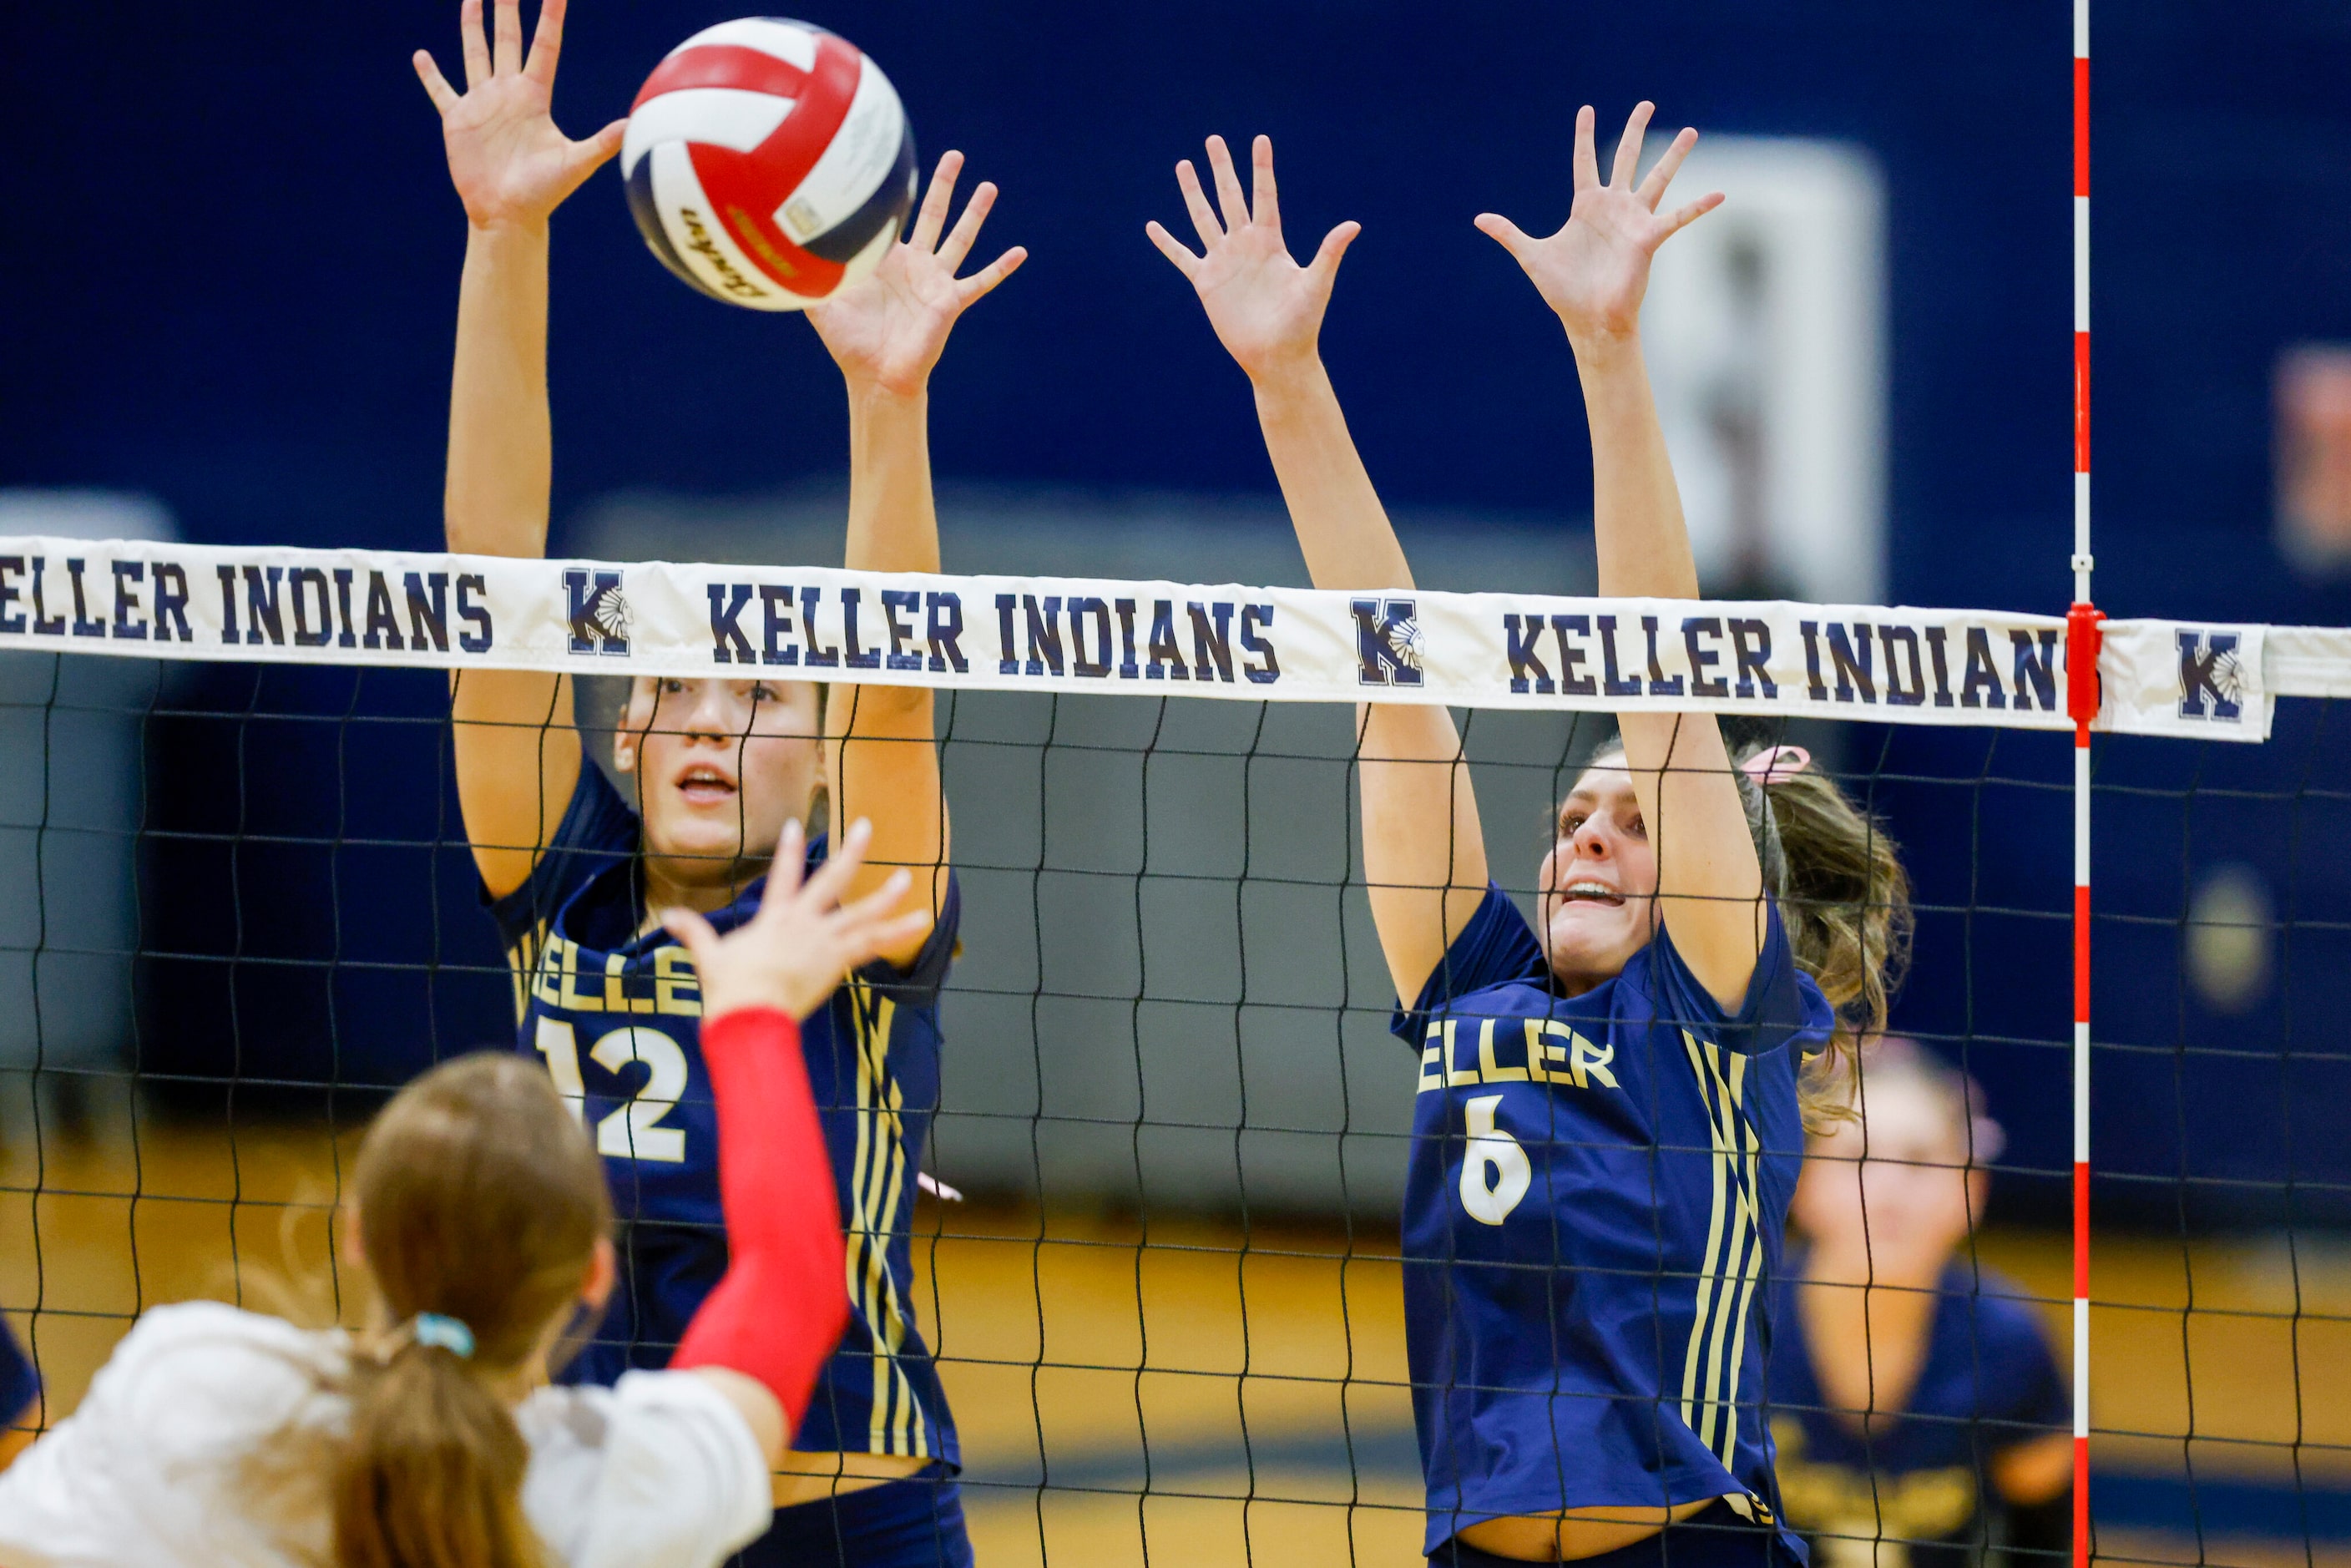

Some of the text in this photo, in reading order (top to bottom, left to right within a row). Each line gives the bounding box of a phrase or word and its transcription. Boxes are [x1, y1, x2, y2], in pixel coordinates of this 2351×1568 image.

[0, 556, 493, 653] ELLER INDIANS
[561, 568, 633, 656] K
[708, 584, 1280, 684] KELLER INDIANS
[1350, 598, 1425, 687] K
[1504, 614, 2101, 711] KELLER INDIAN
[2174, 628, 2247, 722] K
[532, 932, 702, 1016] ELLE
[536, 1015, 688, 1162] 12
[1417, 1018, 1621, 1095] ELLER
[1459, 1095, 1531, 1226] 6
